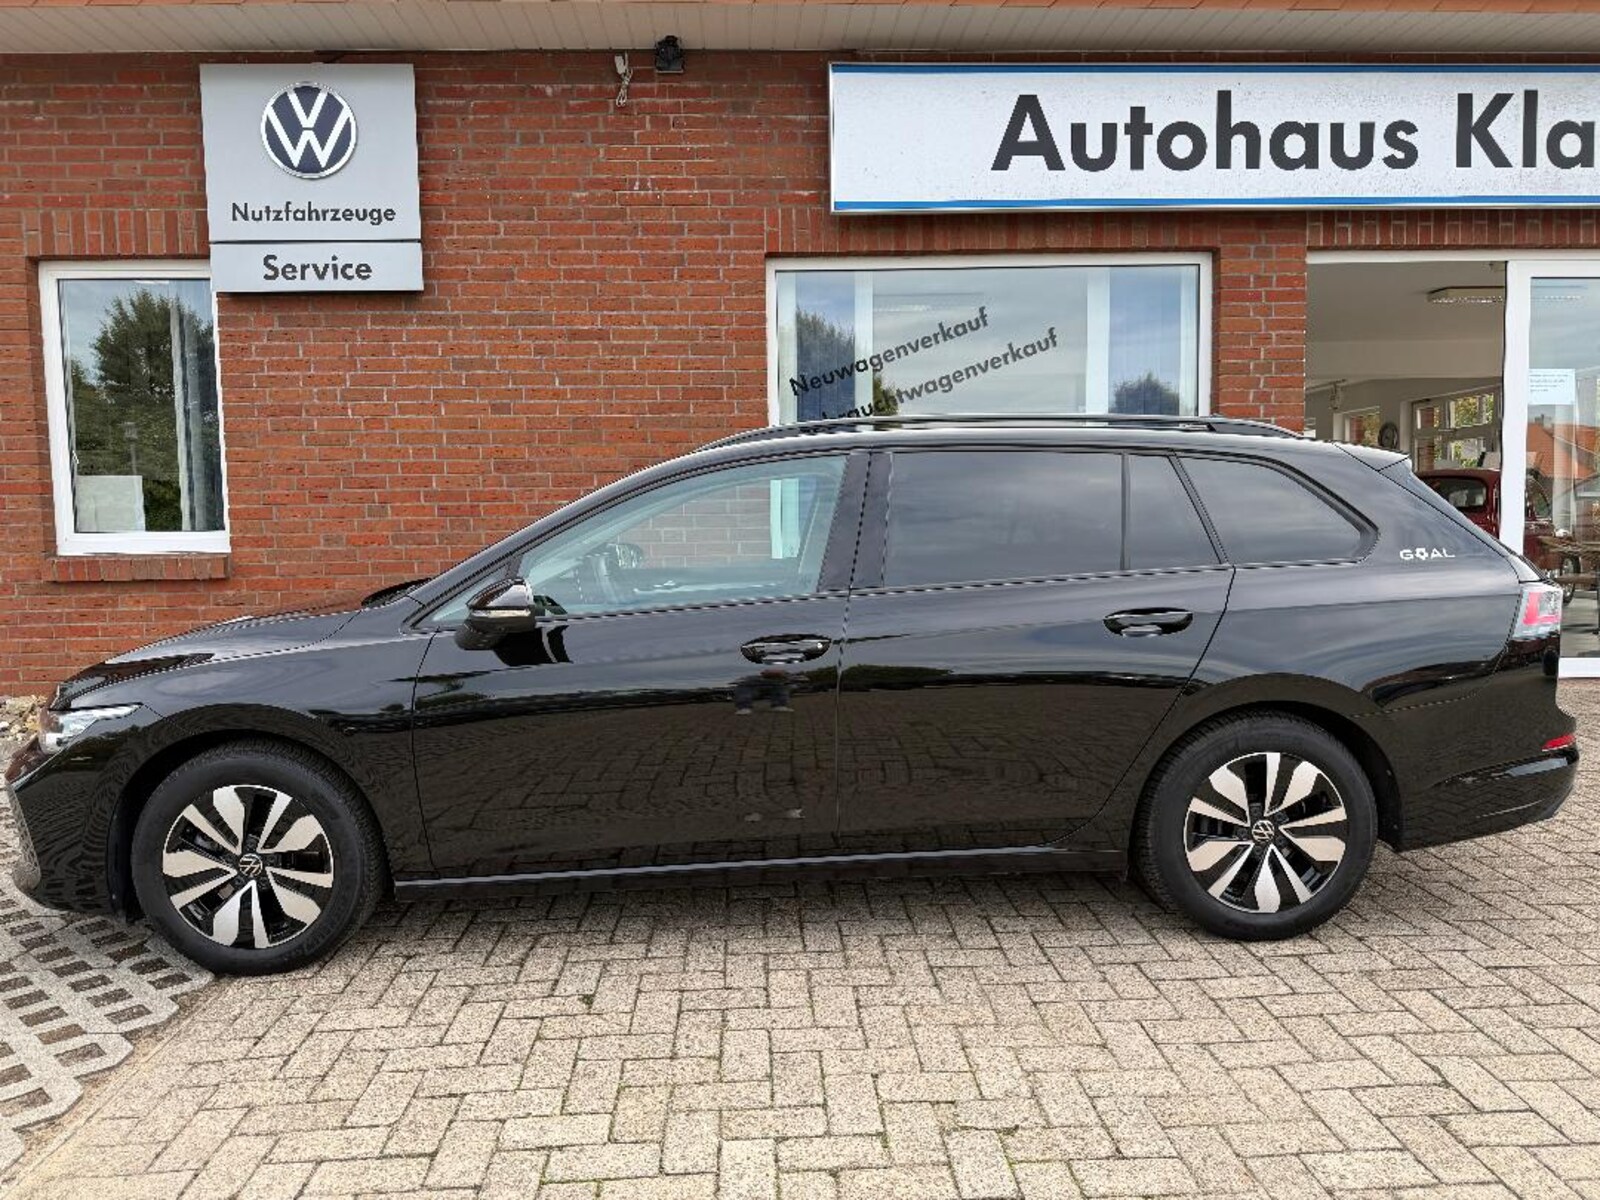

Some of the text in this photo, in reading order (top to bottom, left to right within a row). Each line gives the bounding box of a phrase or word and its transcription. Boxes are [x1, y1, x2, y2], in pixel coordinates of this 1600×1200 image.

[990, 89, 1596, 171] Autohaus Kla
[231, 201, 396, 226] Nutzfahrzeuge
[262, 254, 373, 281] Service
[788, 305, 990, 397] Neuwagenverkauf
[821, 326, 1059, 420] auchtwagenverkauf
